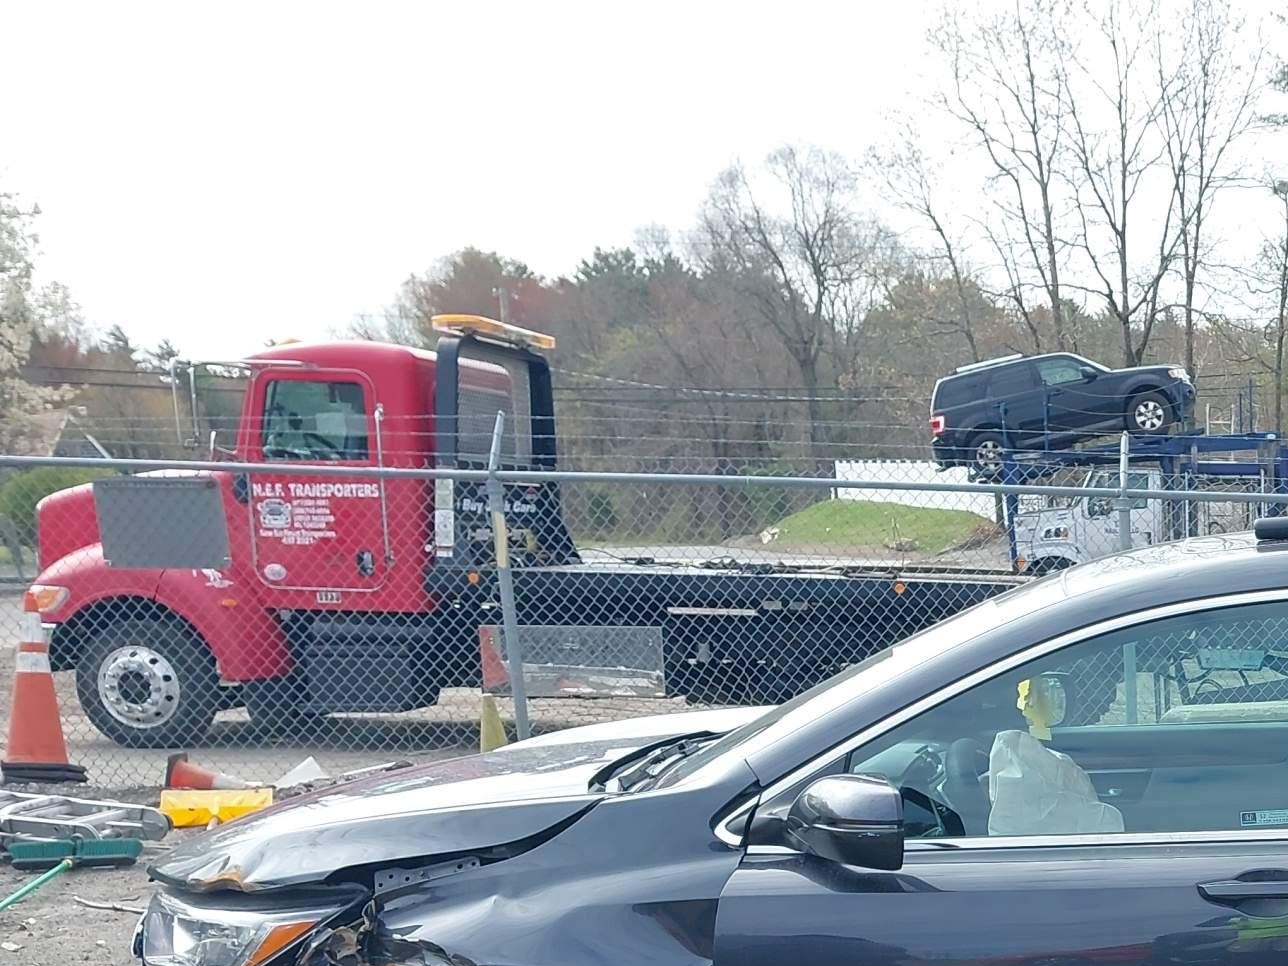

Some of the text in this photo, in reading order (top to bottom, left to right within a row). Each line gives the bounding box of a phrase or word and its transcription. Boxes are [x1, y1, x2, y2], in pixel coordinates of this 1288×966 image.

[288, 483, 379, 498] TRANSPORTERS
[462, 498, 483, 515] Buy
[513, 500, 537, 514] Cars
